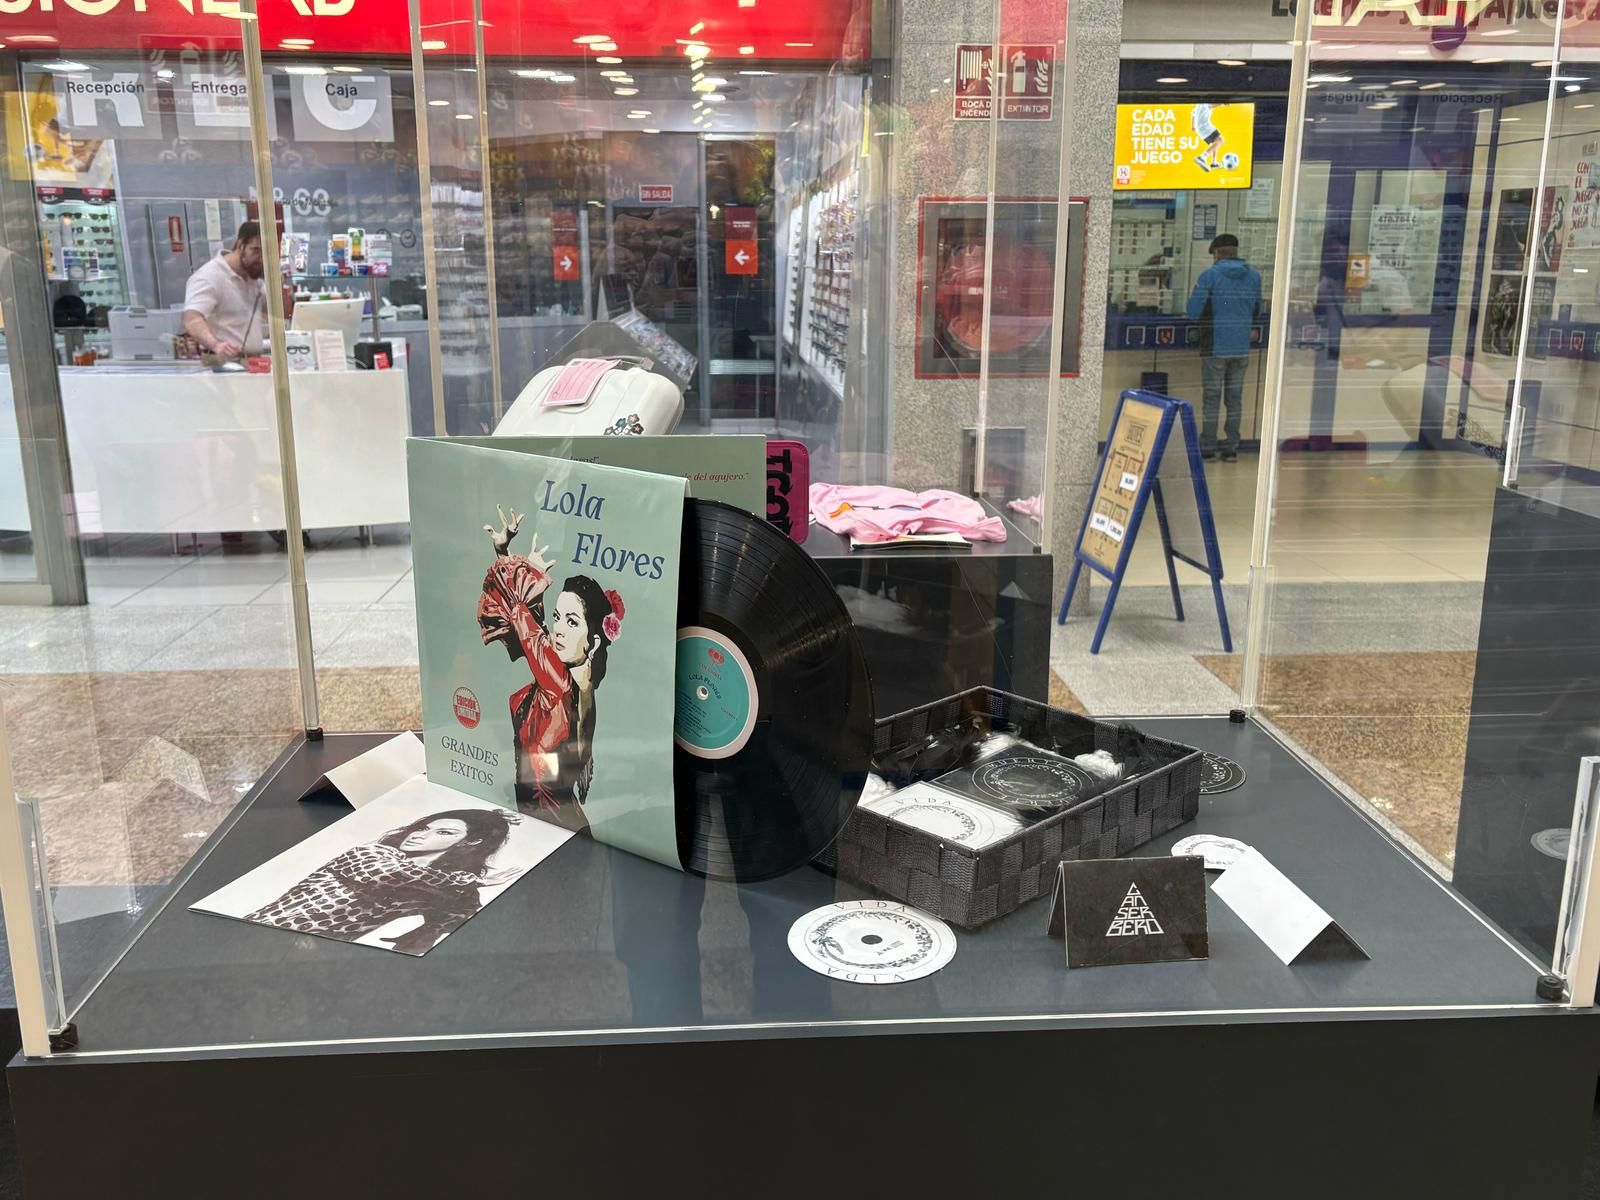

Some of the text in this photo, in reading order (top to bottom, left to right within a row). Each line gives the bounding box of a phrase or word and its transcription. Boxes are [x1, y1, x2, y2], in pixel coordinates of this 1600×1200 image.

[66, 81, 144, 95] Recepción
[191, 81, 247, 96] Entrega
[325, 84, 358, 97] Caja
[961, 100, 985, 108] BOCA
[1007, 105, 1049, 113] EXTINTOR
[960, 109, 992, 117] INCENDI
[1132, 109, 1176, 122] CADA
[1131, 123, 1174, 136] EDAD
[1131, 136, 1199, 150] TIENE SU
[1130, 151, 1182, 164] JUEGO
[540, 480, 606, 521] Lola
[571, 532, 666, 580] Flores
[441, 735, 499, 767] GRANDES
[450, 759, 494, 786] EXITOS
[896, 798, 951, 806] VIDA
[833, 900, 907, 912] VIDA
[1114, 906, 1155, 920] SER
[1105, 918, 1165, 937] BERO
[827, 967, 905, 983] VIDA
